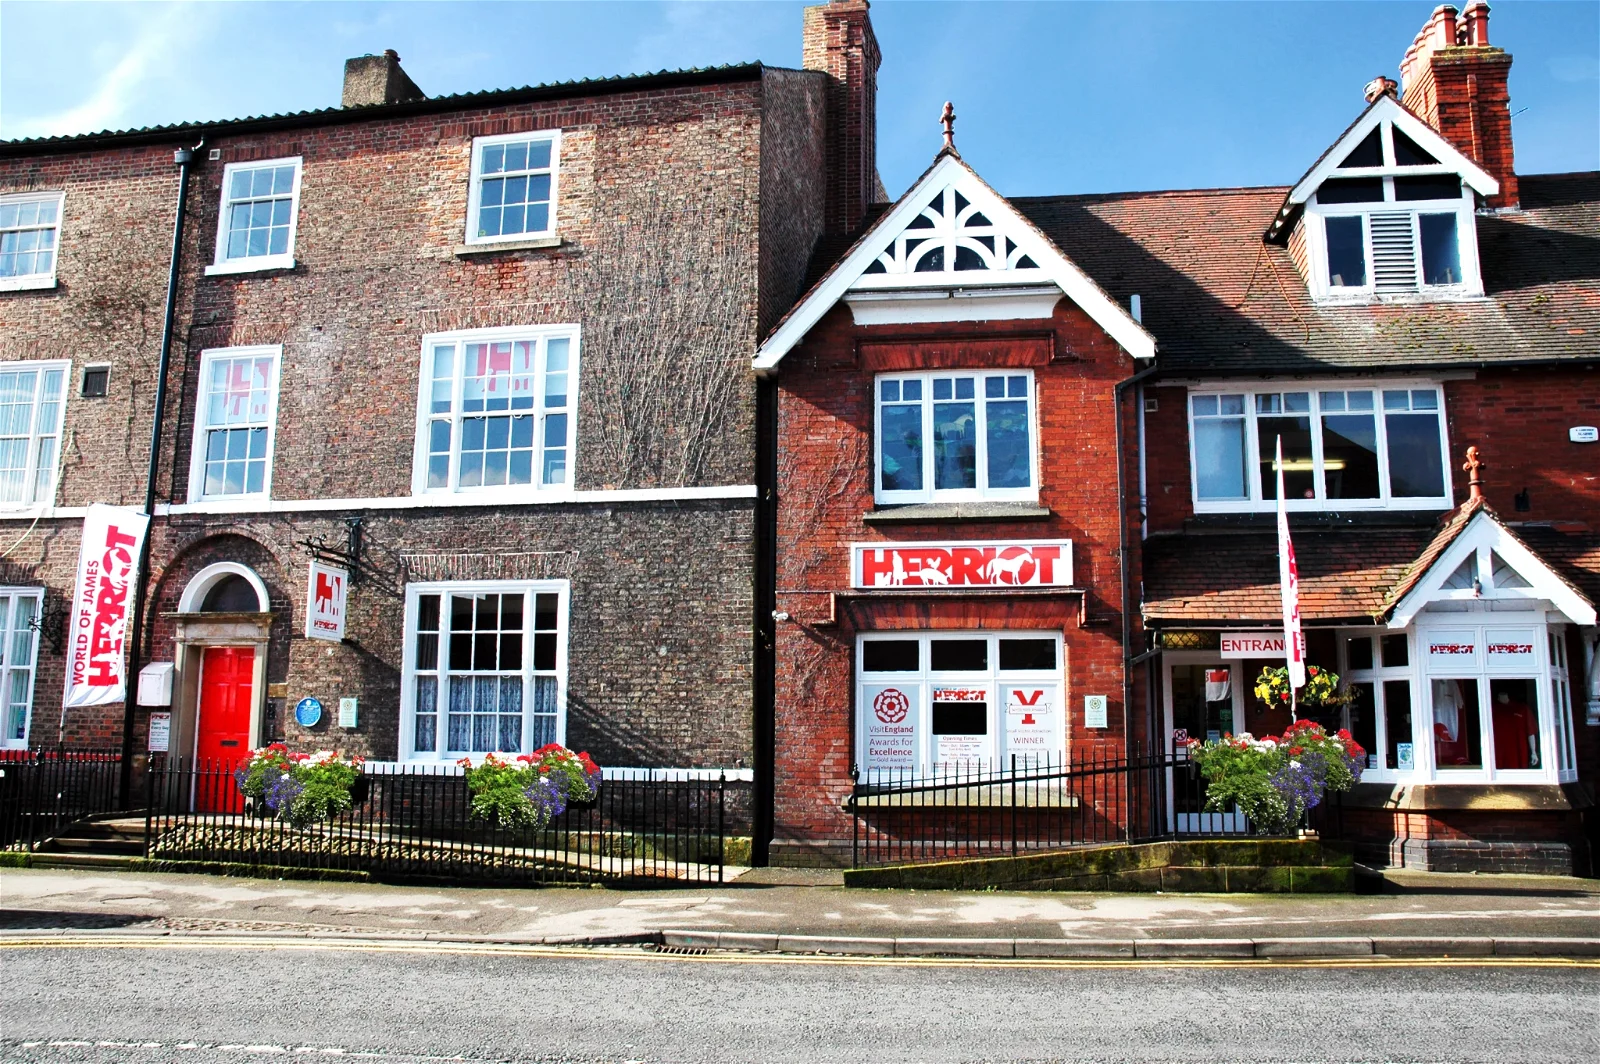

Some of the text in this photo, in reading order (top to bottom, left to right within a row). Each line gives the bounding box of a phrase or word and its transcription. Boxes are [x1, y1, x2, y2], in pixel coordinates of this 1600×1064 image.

[863, 546, 1060, 586] HERRIOT
[88, 525, 137, 686] HERRIOT
[73, 560, 99, 686] WORLD OF JAMES
[1222, 639, 1305, 652] ENTRAN
[933, 690, 986, 701] HERRIOT
[869, 726, 914, 734] VisitEngland
[869, 738, 913, 746] Awards for
[869, 748, 913, 756] Excellence
